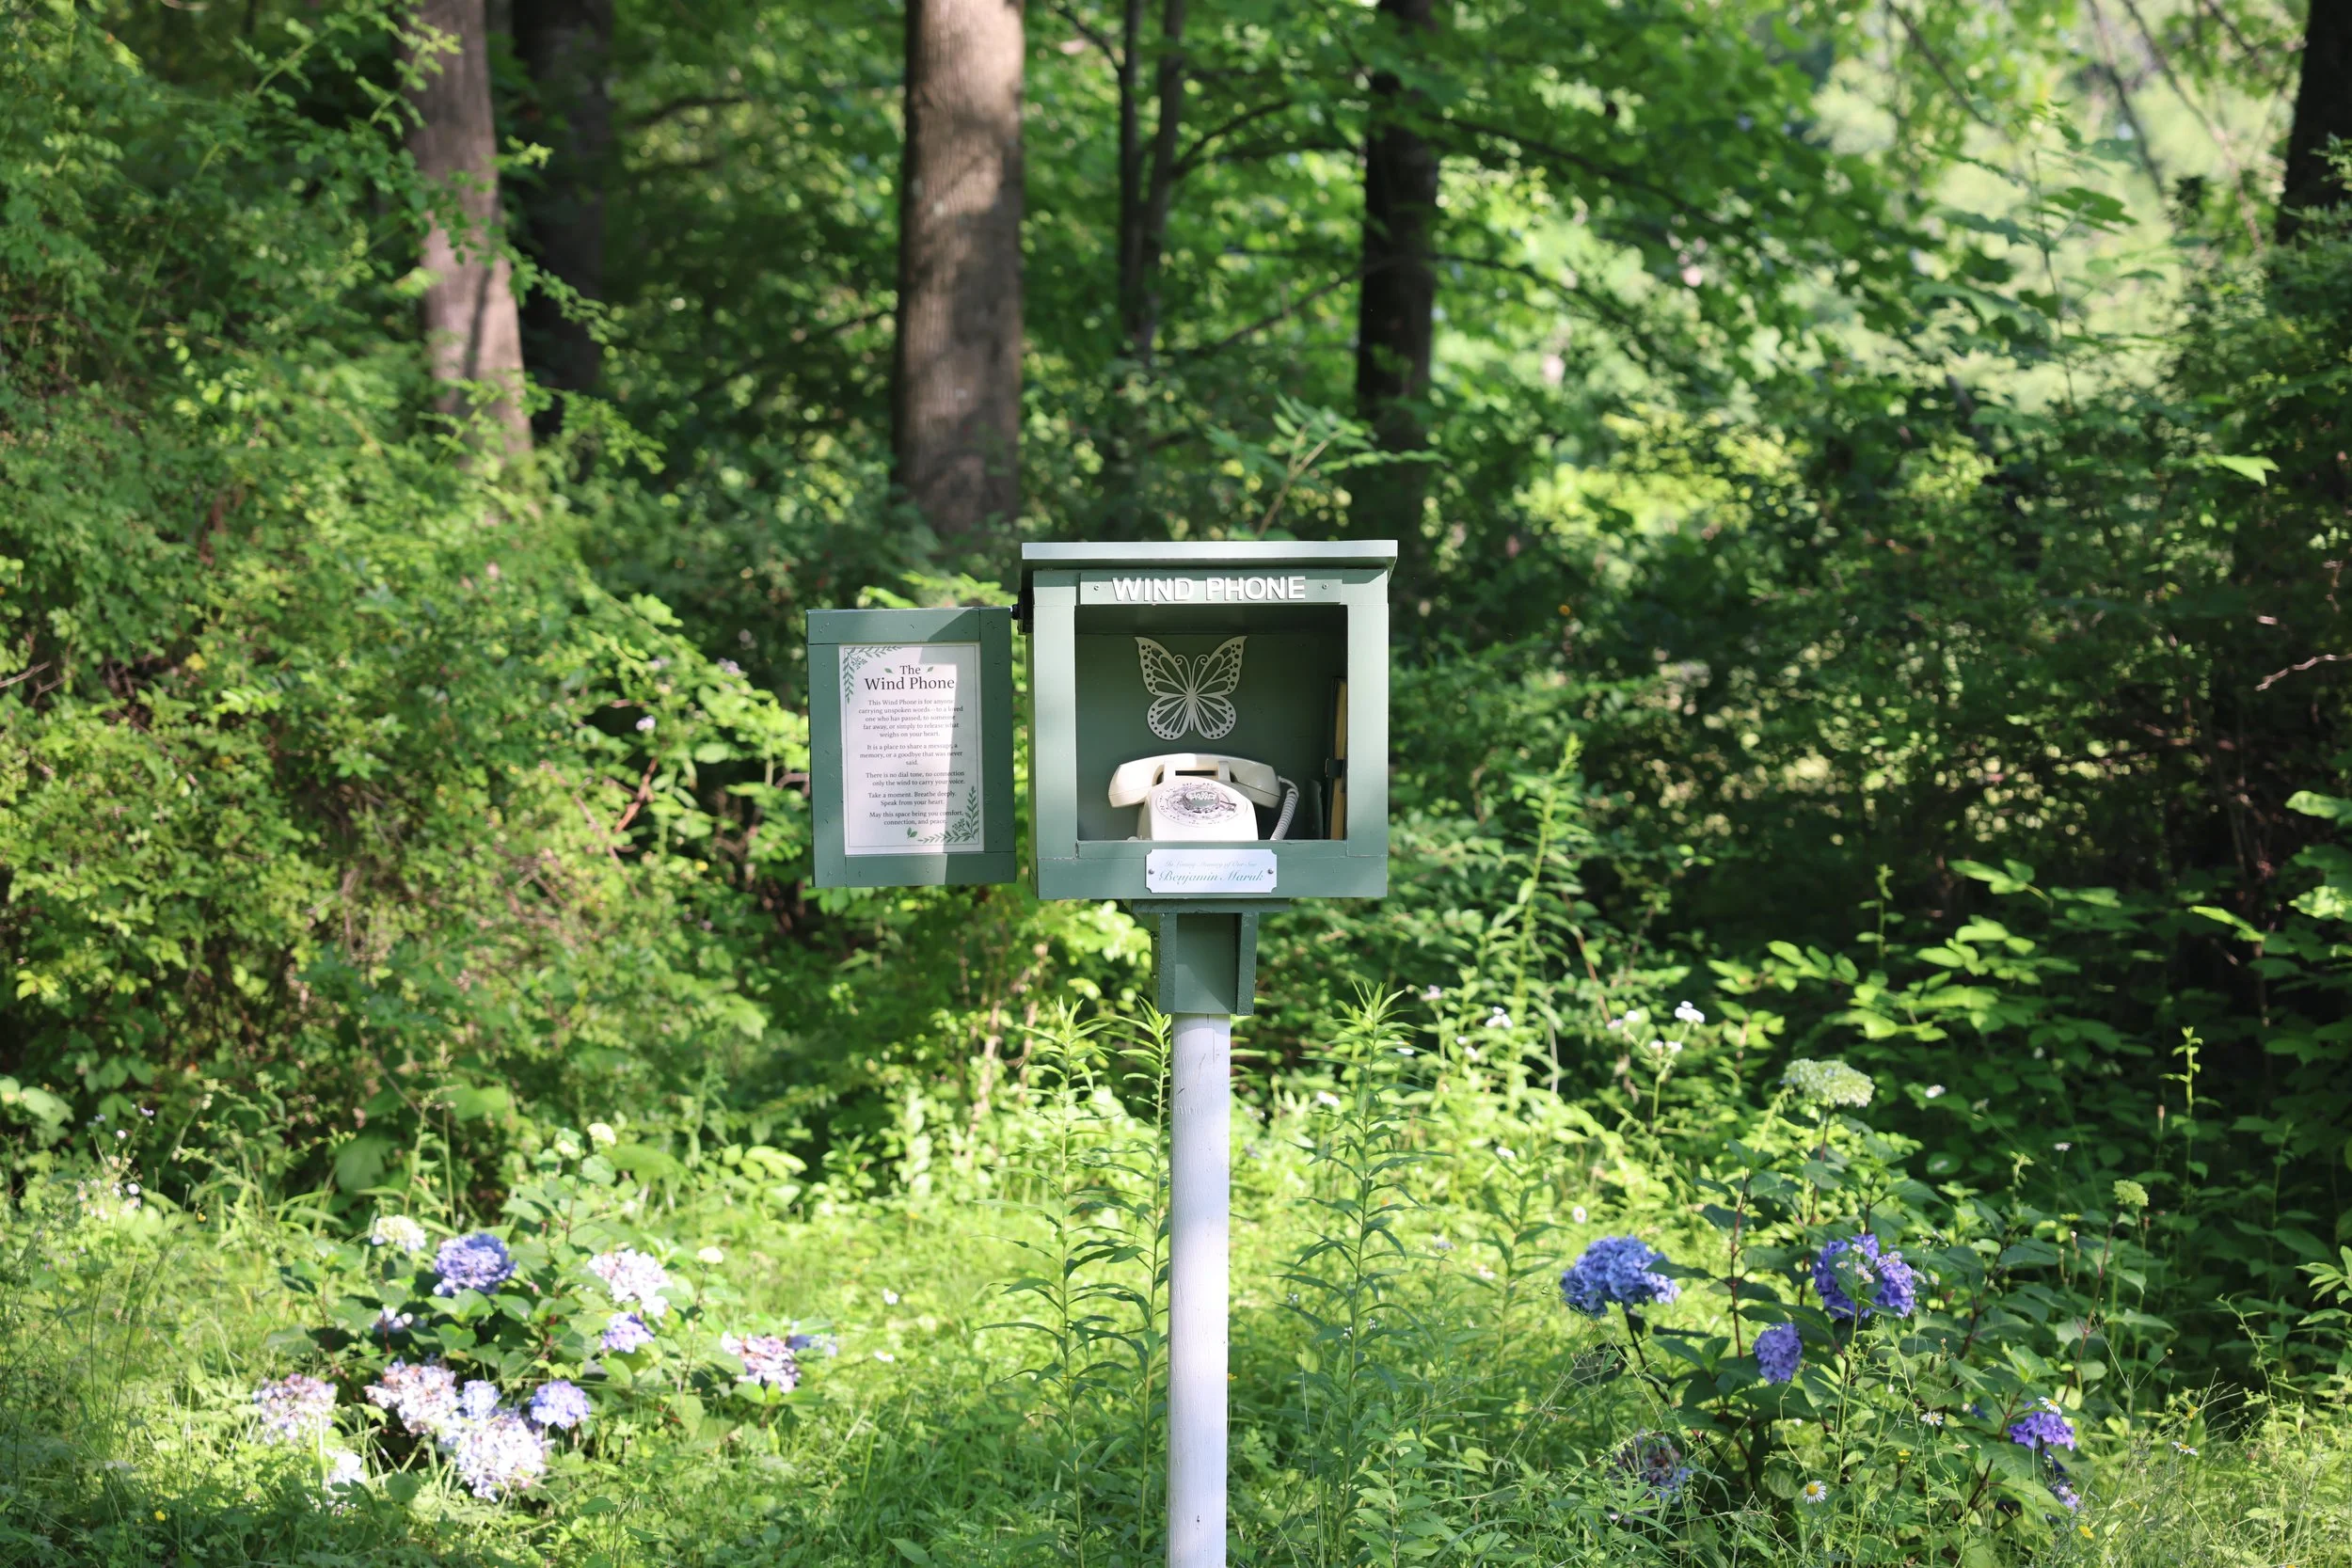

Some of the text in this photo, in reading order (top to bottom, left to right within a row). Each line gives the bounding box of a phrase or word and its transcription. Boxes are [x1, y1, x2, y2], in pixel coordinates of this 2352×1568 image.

[1112, 576, 1306, 601] WIND PHONE
[899, 665, 921, 675] The
[865, 677, 955, 690] Wind Phone
[1159, 870, 1264, 885] Benjamin Maruk
